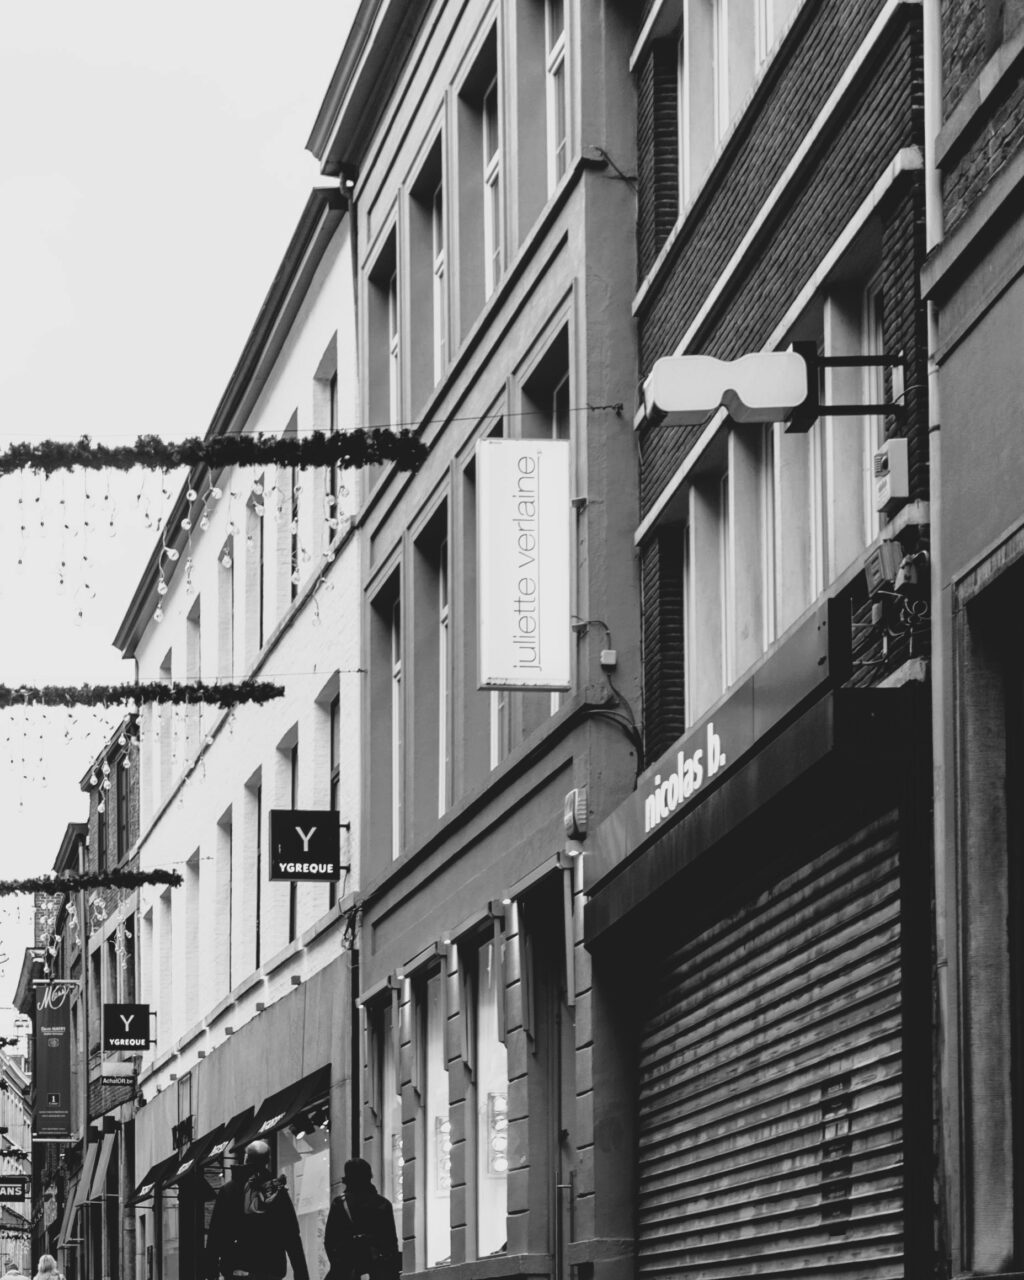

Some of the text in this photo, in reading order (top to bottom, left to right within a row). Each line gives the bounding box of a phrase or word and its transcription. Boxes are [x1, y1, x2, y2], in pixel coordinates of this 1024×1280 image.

[512, 456, 542, 671] juliette verlaine
[645, 722, 726, 833] nicolas b.
[295, 826, 317, 852] Y
[279, 862, 334, 874] YGREQUE
[119, 1014, 135, 1032] Y
[109, 1038, 146, 1046] YGREQUE
